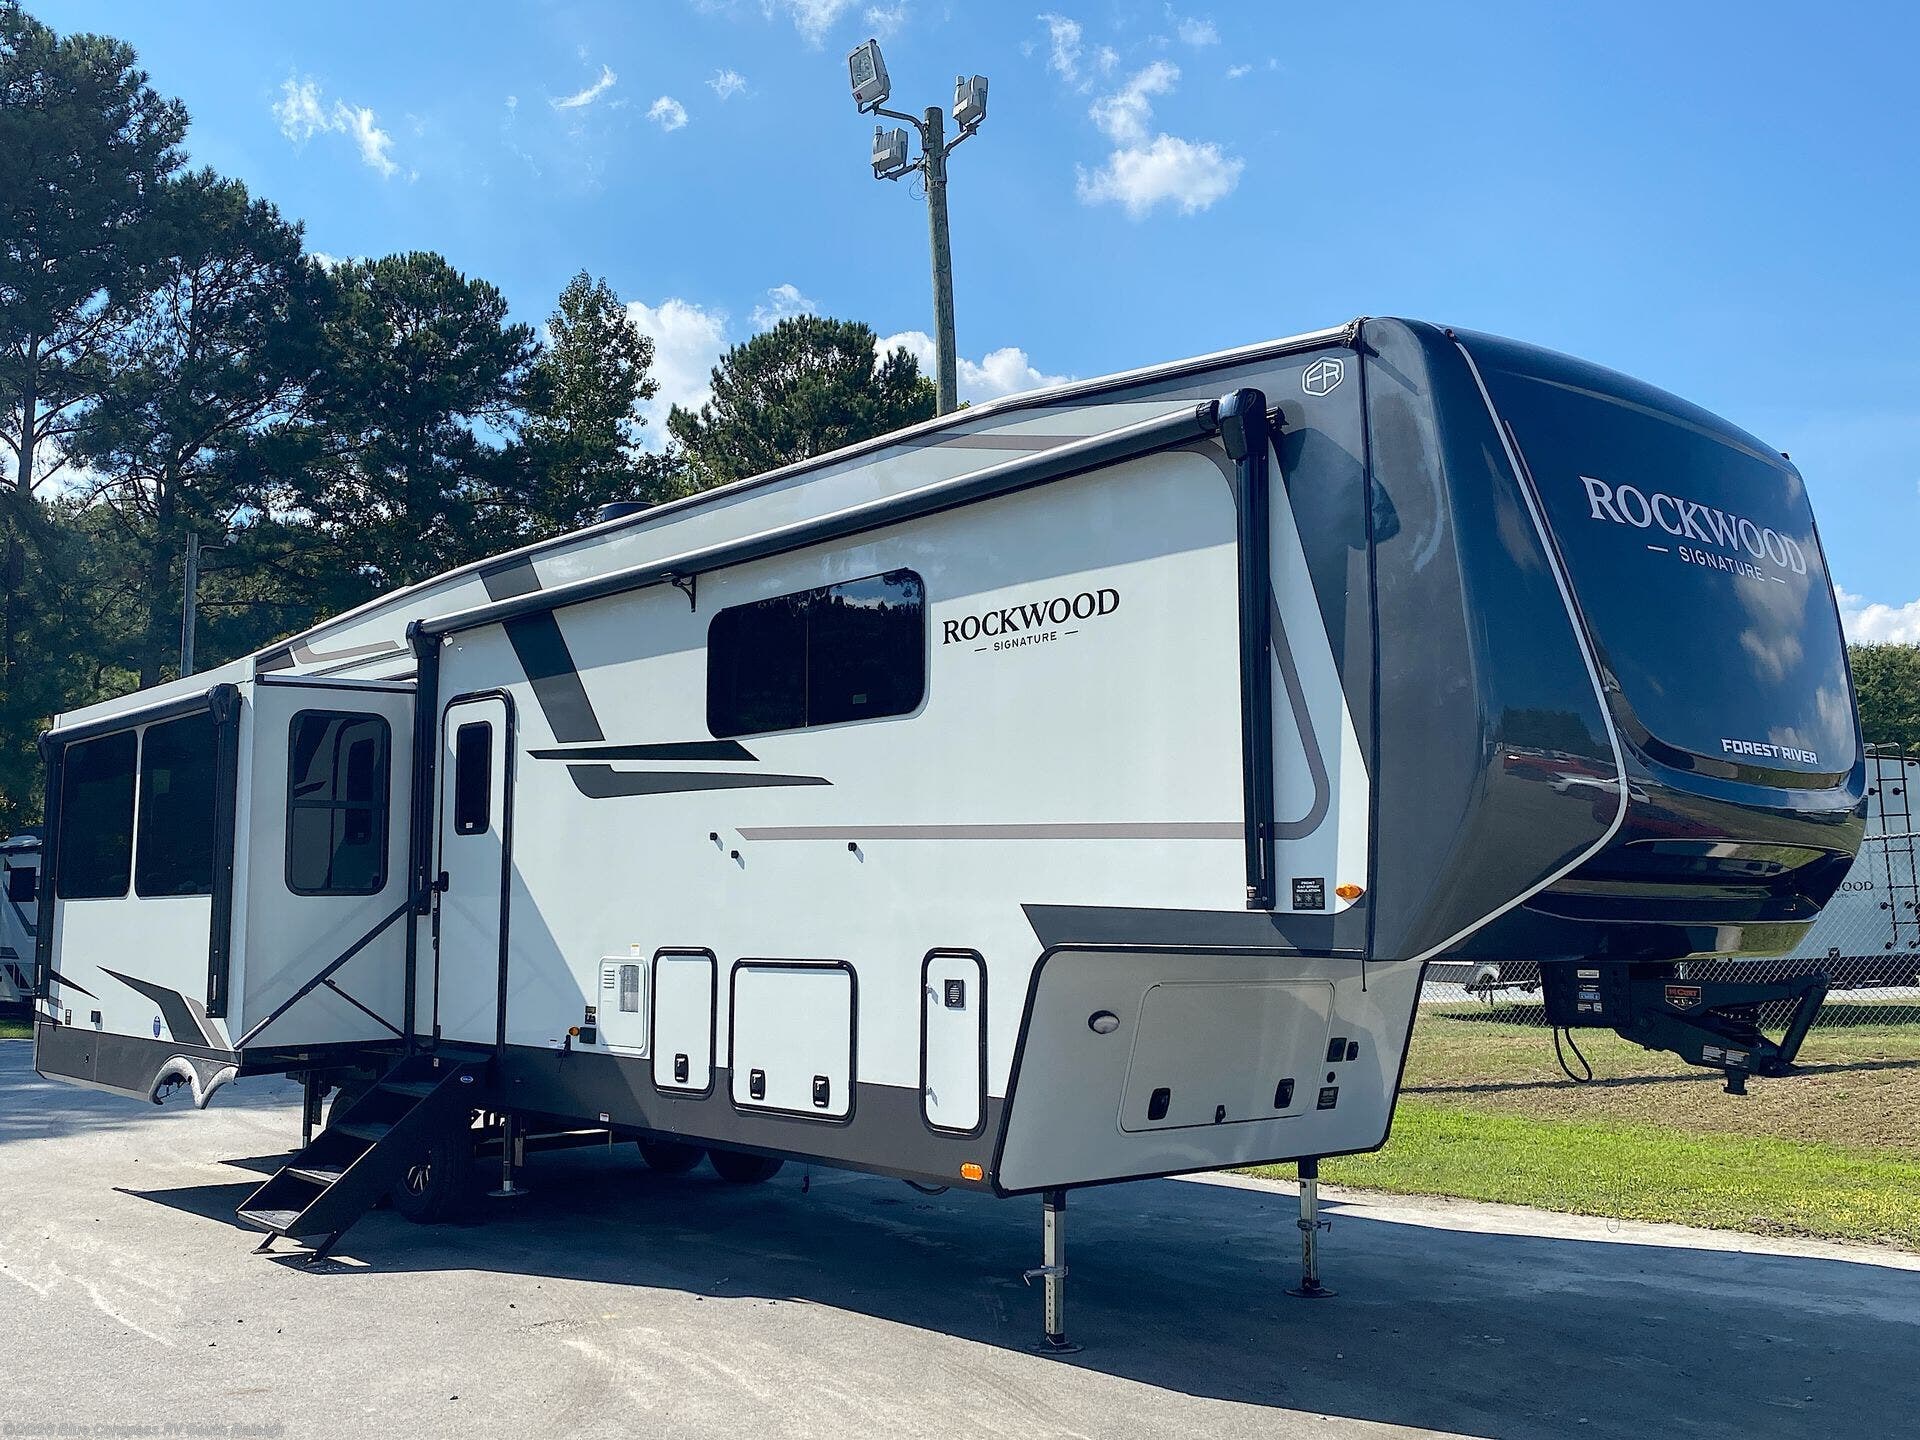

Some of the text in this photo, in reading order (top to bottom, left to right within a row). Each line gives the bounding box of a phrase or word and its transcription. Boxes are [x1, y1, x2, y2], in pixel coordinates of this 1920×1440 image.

[1579, 475, 1807, 576] ROCKWOOD
[1678, 545, 1765, 582] SIGNATURE
[942, 588, 1120, 645] ROCKWOOD
[993, 631, 1057, 652] SIGNATURE
[1721, 738, 1819, 765] FOREST RIVER
